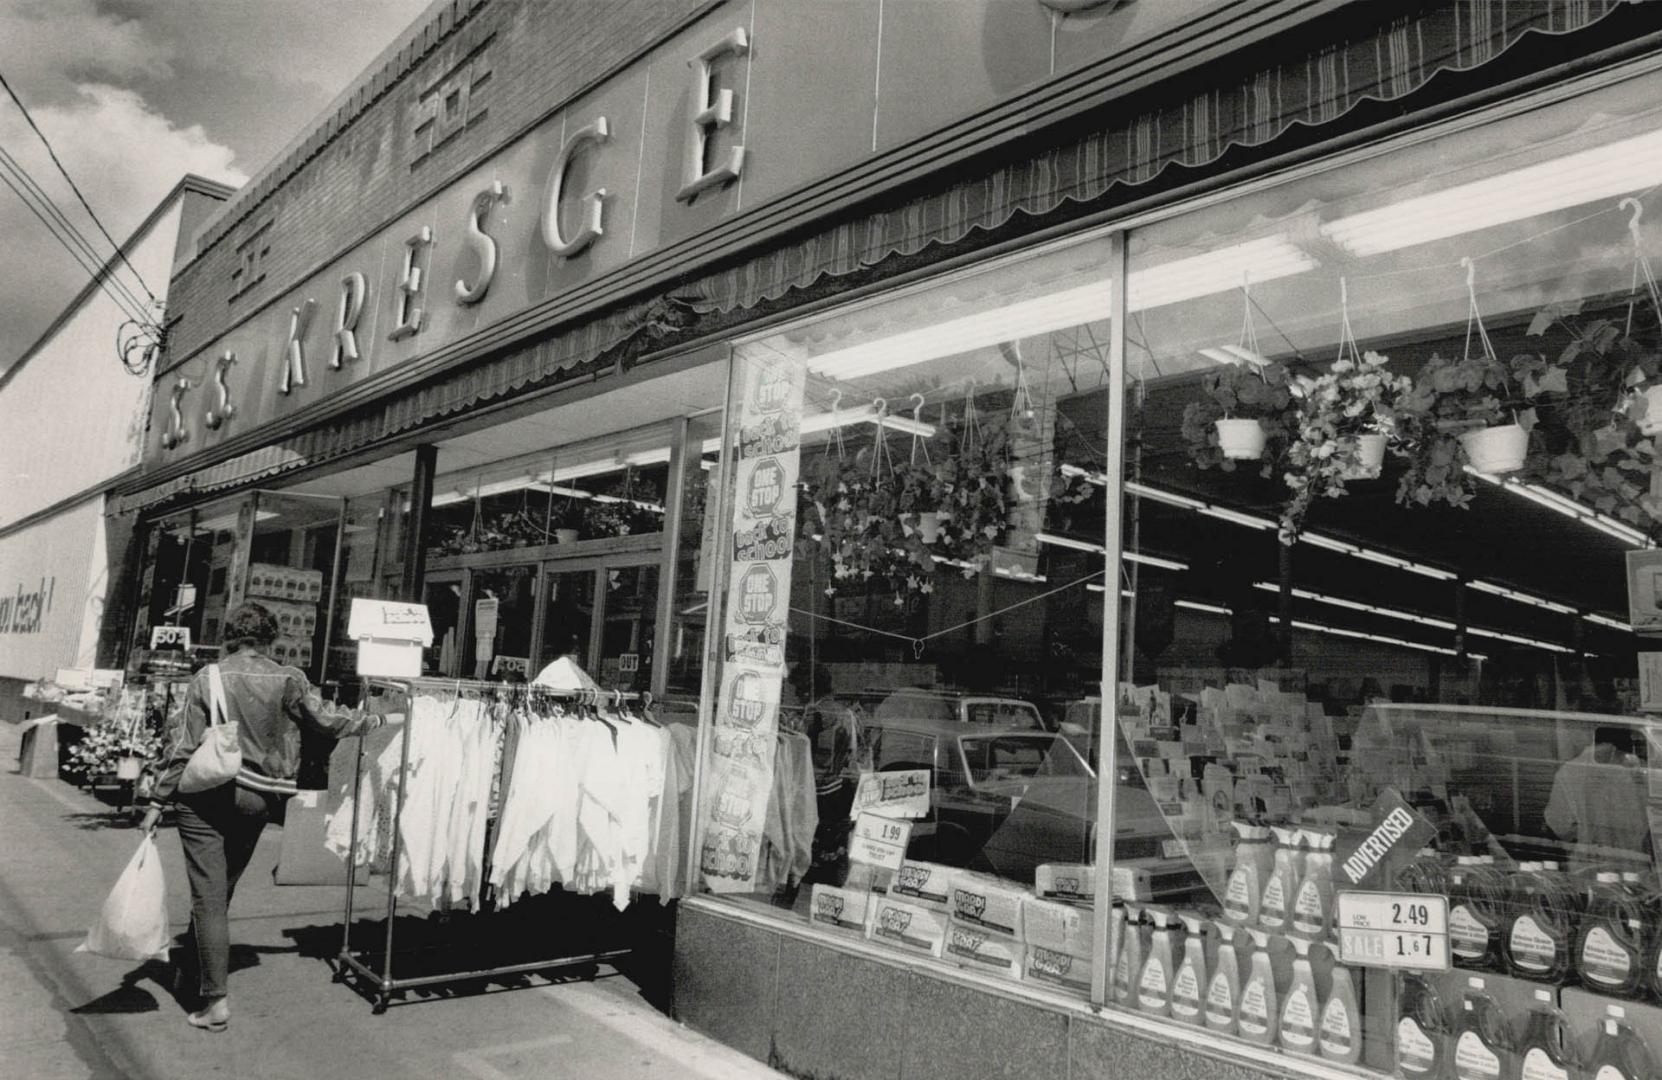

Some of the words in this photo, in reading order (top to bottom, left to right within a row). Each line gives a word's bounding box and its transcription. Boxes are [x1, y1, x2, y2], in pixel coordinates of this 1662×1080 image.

[162, 378, 191, 450] S
[206, 349, 239, 430] S
[279, 26, 749, 397] KRESGE
[754, 466, 777, 487] ONE
[751, 485, 780, 507] STOP
[737, 521, 768, 548] back
[771, 518, 788, 535] to
[737, 531, 791, 562] school
[744, 592, 773, 613] STOP
[732, 699, 762, 721] STOP
[881, 824, 901, 841] 1.99
[1342, 807, 1414, 884] ADVERTISED
[955, 890, 987, 906] MARDI
[1391, 903, 1429, 925] 2.49
[1343, 934, 1385, 957] SALE
